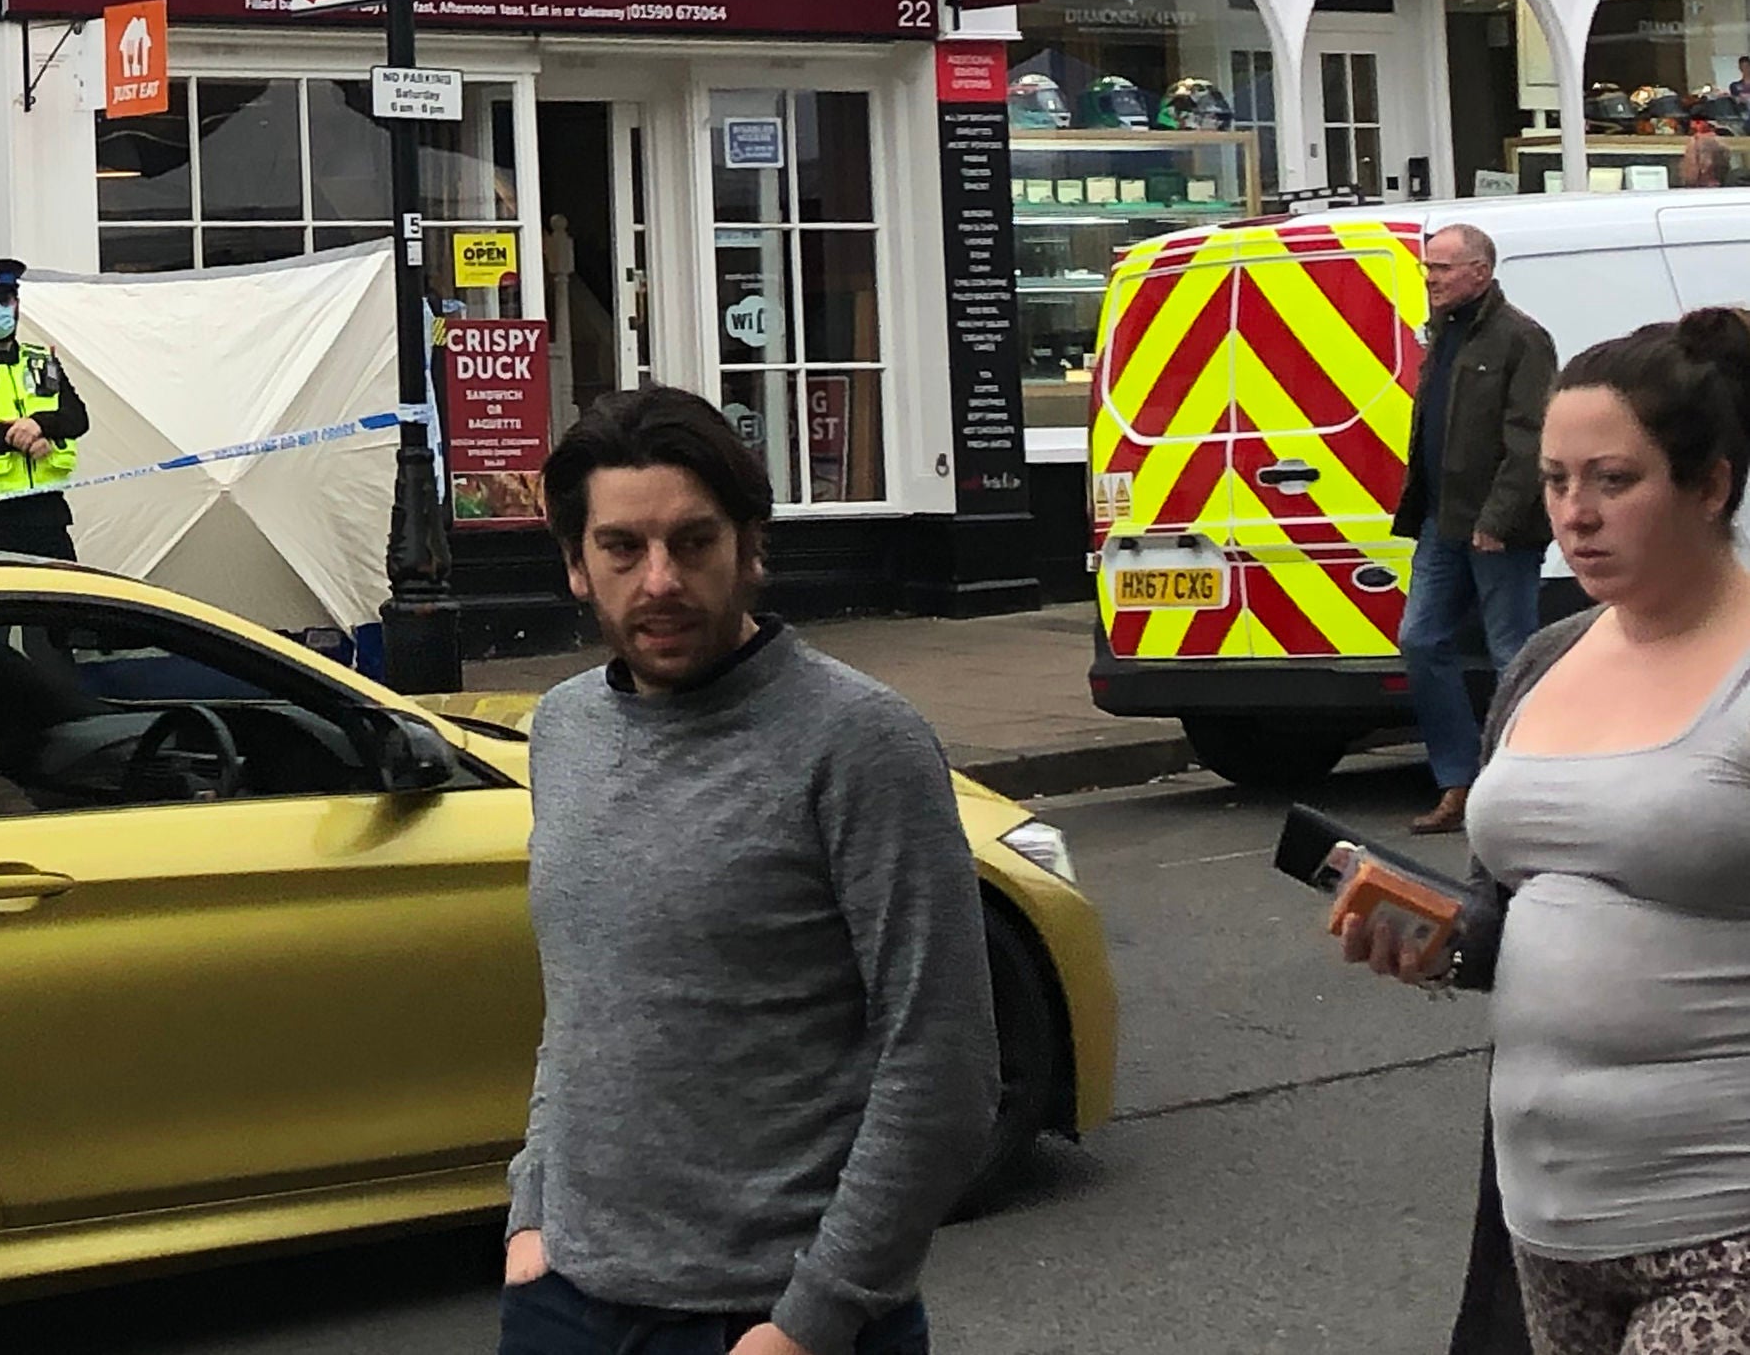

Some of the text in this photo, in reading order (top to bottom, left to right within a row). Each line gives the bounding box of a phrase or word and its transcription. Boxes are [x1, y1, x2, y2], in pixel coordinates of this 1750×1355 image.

[897, 0, 932, 28] 22
[382, 72, 452, 86] NO PARKING
[112, 79, 160, 105] JUST EAT
[395, 87, 440, 102] Saturday
[463, 246, 507, 261] OPEN
[446, 328, 541, 353] CRISPY
[456, 355, 532, 380] DUCK
[465, 389, 524, 401] SANDWICH
[486, 404, 503, 415] OR
[468, 418, 522, 430] BAGUETTE
[1121, 571, 1214, 600] HX67 CXG
